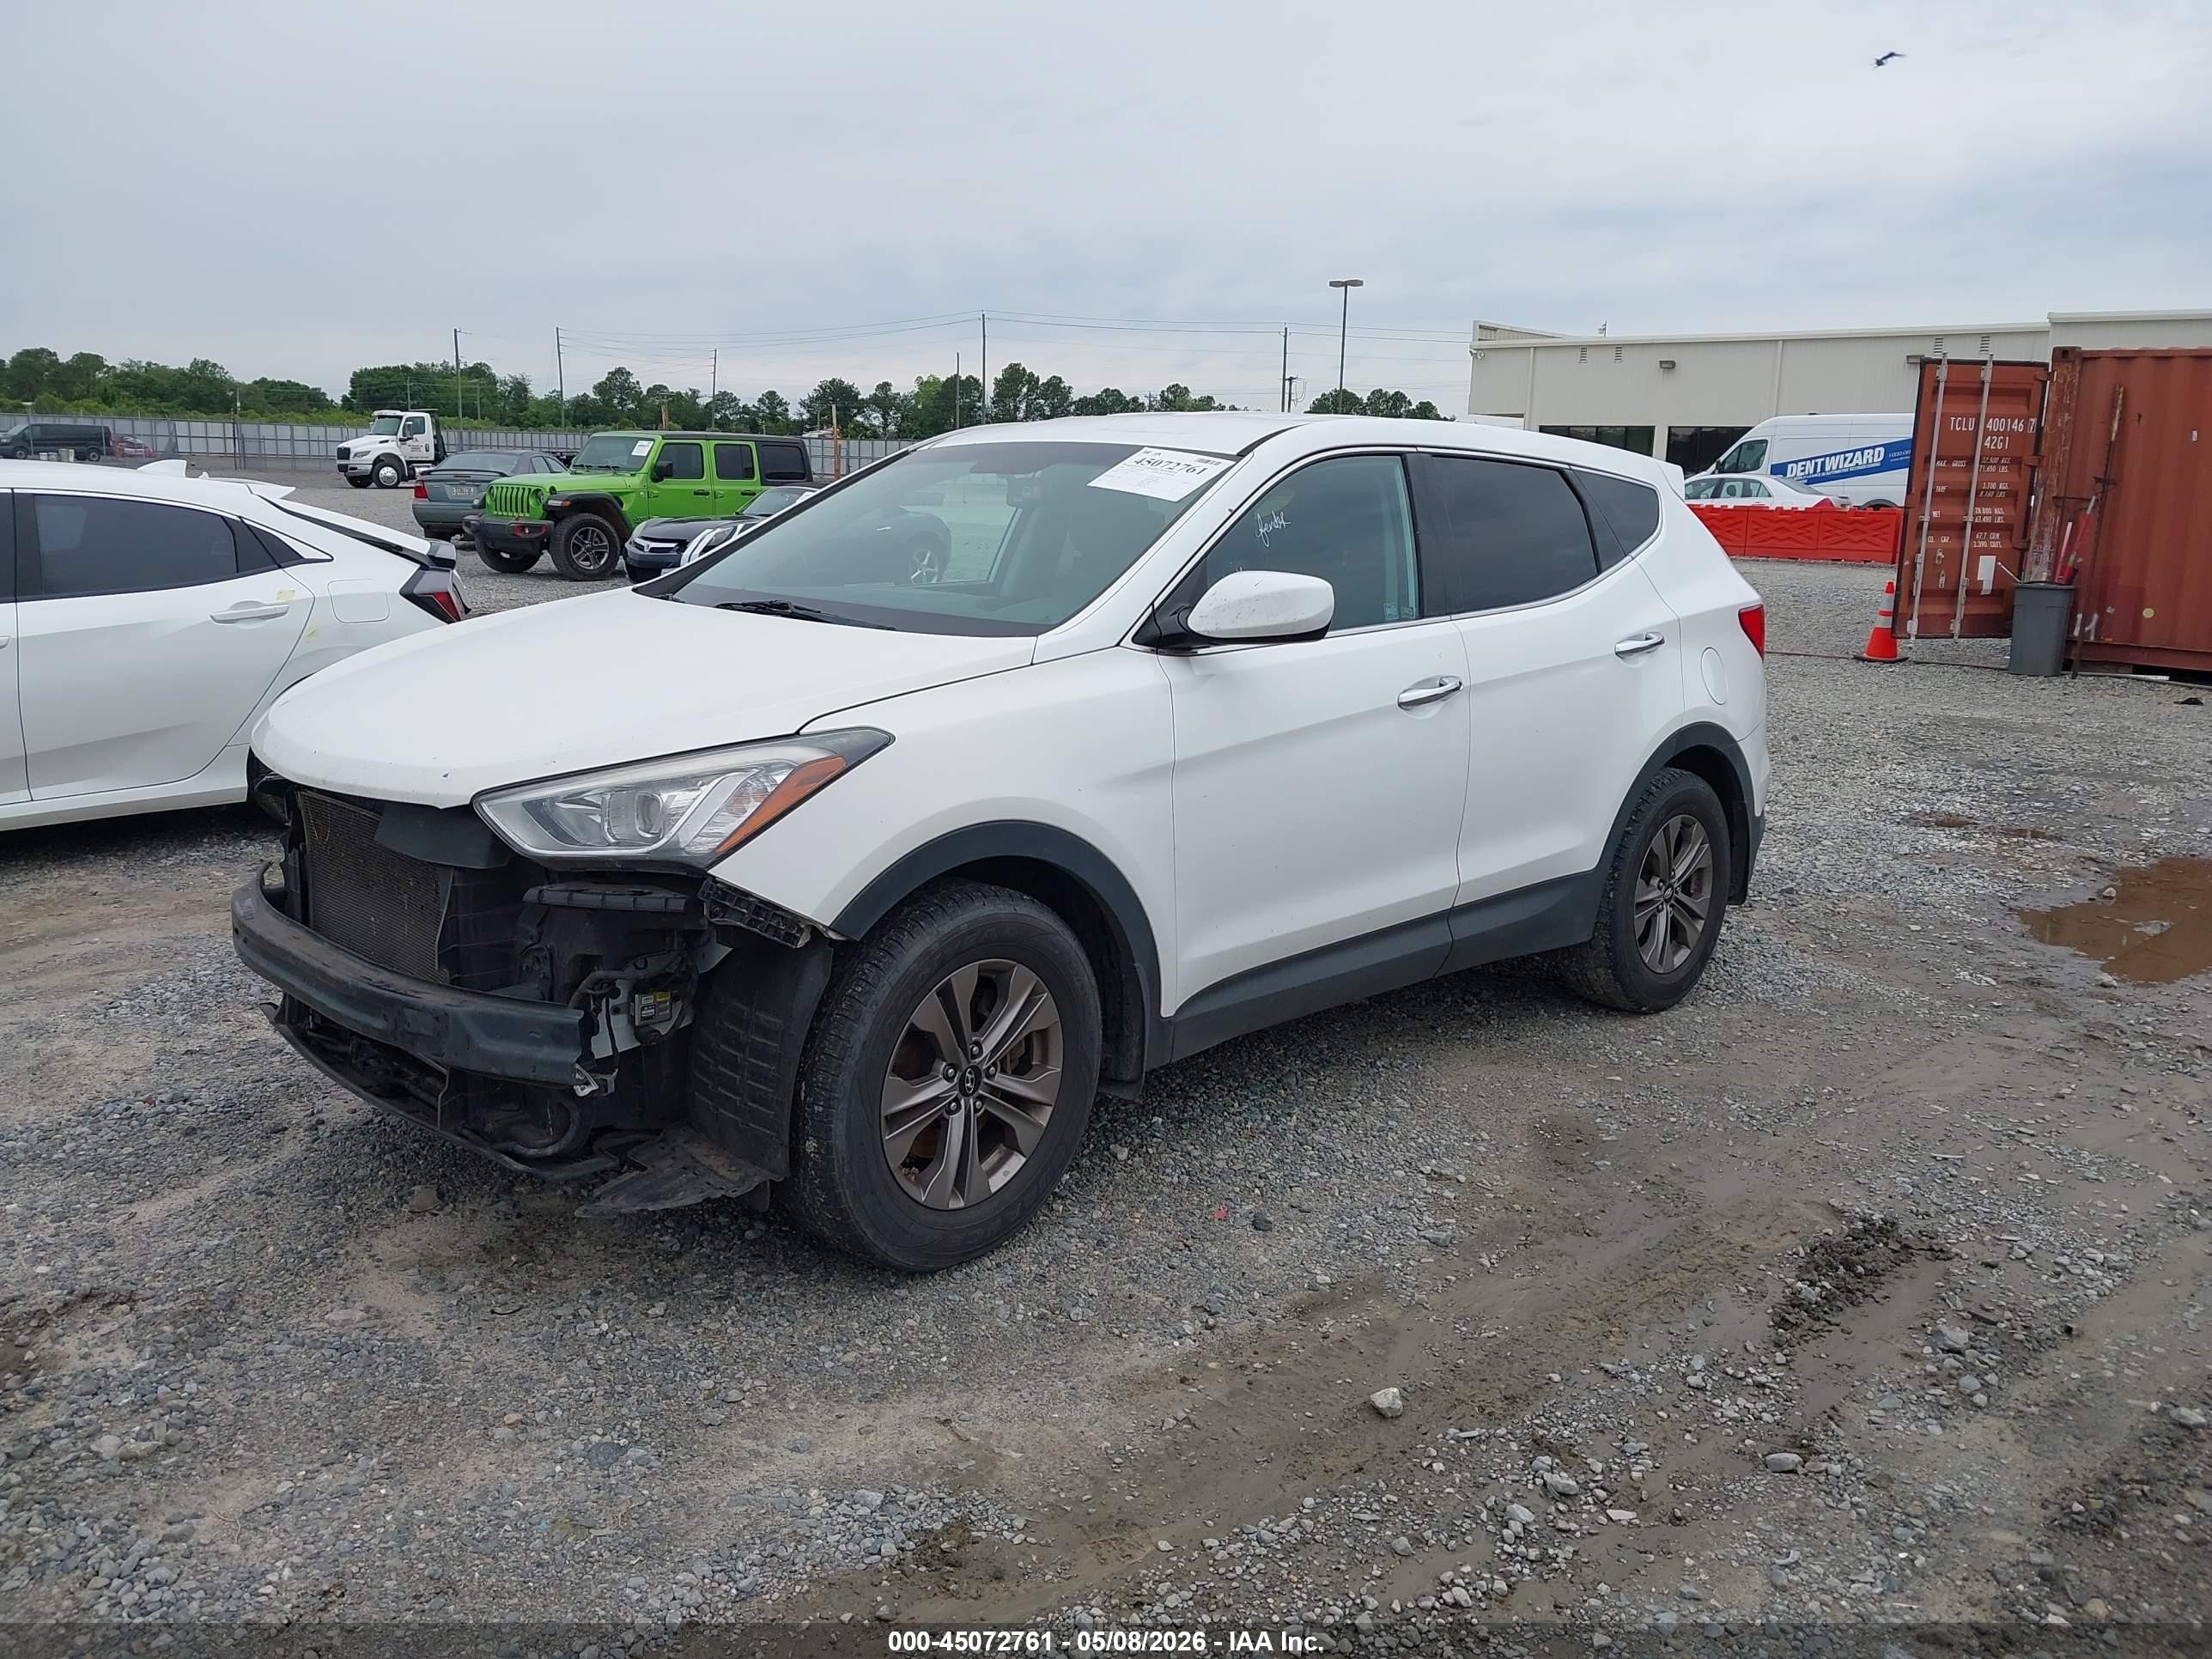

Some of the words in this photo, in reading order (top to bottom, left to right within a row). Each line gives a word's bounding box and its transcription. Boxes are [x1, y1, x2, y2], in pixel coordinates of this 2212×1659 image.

[1950, 417, 1975, 431] TCLU
[1986, 418, 2025, 432] 400146
[2028, 419, 2037, 432] 7
[1984, 436, 2009, 449] 42G1
[1133, 457, 1209, 476] 45072761
[1786, 458, 1826, 478] DENT
[1825, 447, 1885, 473] WIZARD
